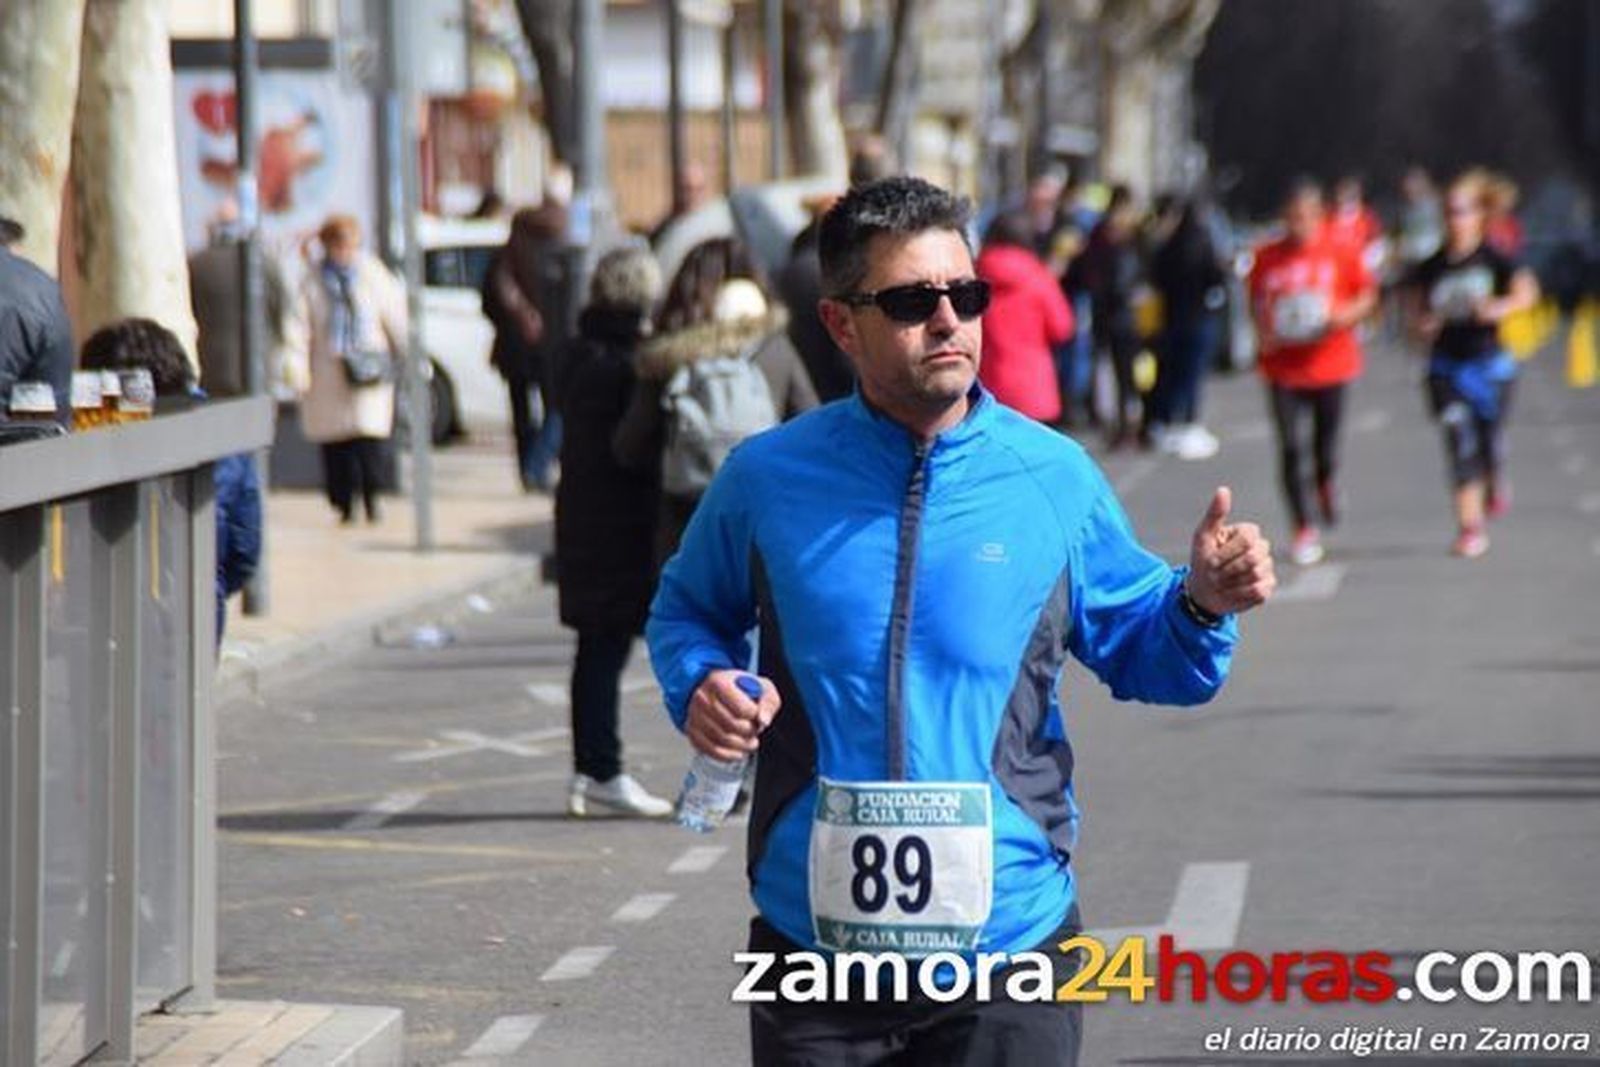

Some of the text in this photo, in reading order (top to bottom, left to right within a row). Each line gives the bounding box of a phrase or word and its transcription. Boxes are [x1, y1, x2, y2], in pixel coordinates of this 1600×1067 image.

[903, 808, 962, 823] RURAL
[851, 835, 933, 914] 89
[903, 931, 963, 949] RURAL
